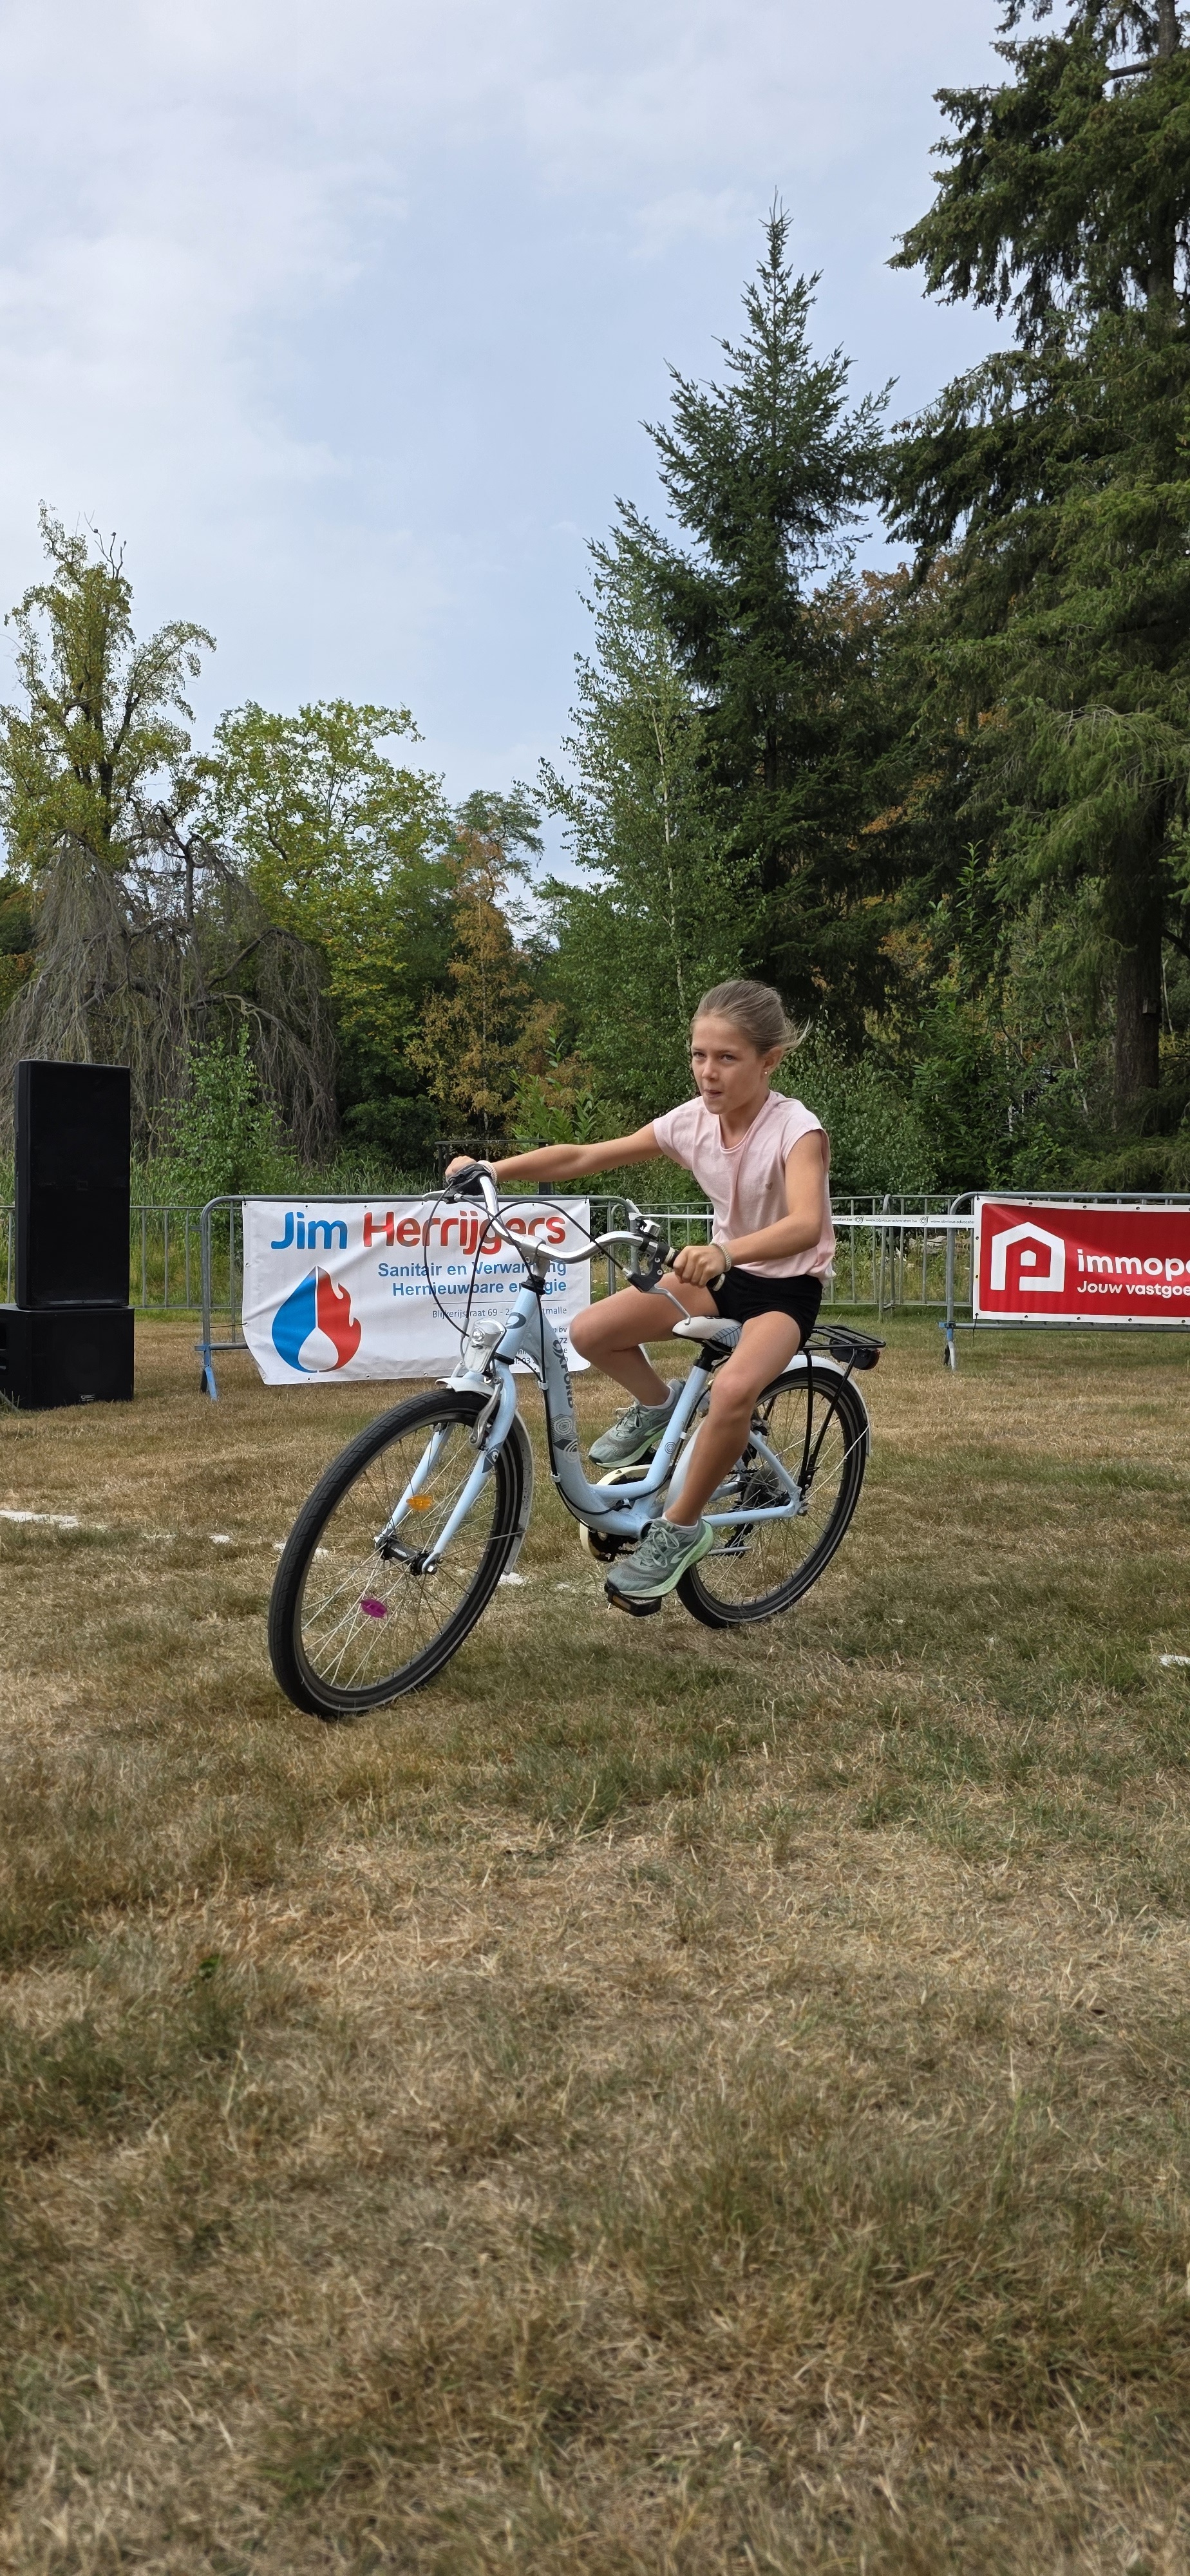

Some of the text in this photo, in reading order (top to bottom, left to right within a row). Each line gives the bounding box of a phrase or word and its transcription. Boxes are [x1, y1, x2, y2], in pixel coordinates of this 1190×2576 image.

[271, 1210, 566, 1255] Jim Herrijgers
[378, 1262, 567, 1277] Sanitair en Verwarng
[1077, 1249, 1190, 1281] immop
[392, 1278, 567, 1296] Hernieuwbare egie
[1077, 1281, 1123, 1293] Jouw
[433, 1309, 486, 1319] Blijkerijsraat
